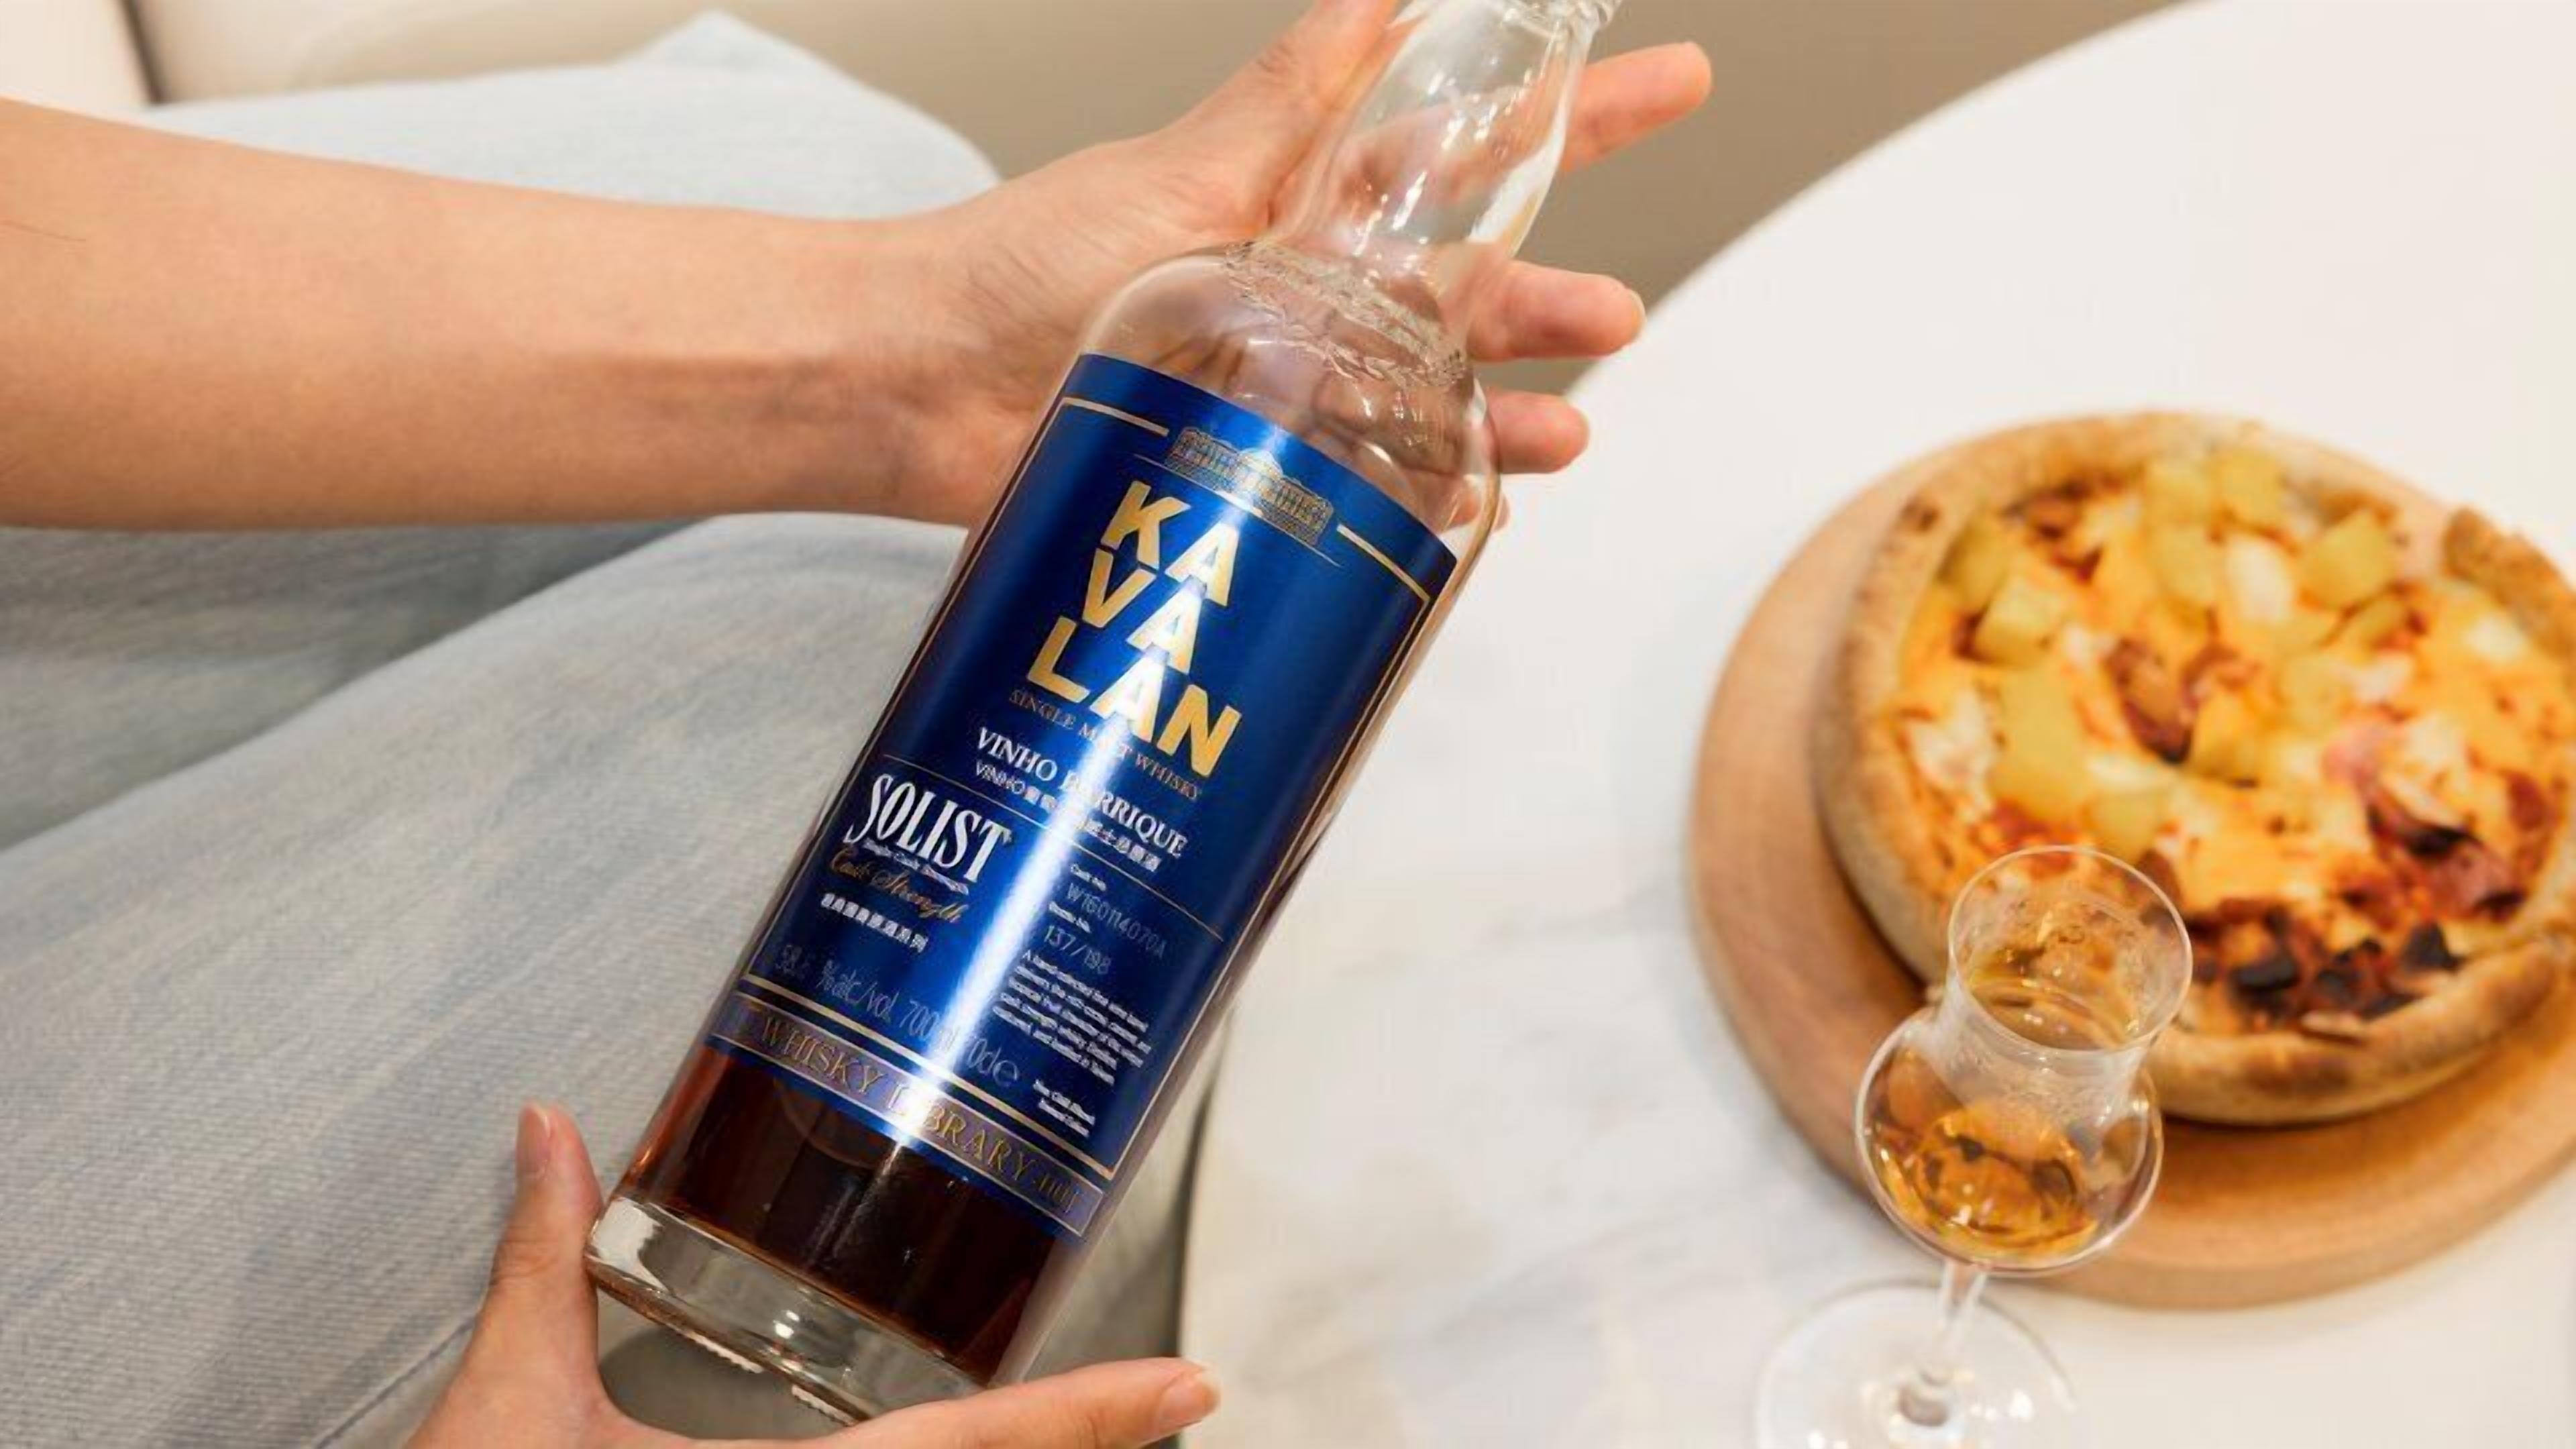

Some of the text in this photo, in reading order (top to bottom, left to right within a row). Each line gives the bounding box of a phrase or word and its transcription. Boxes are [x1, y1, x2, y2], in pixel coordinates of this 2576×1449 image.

[1101, 480, 1240, 606] KA
[1082, 548, 1206, 675] VA
[1009, 688, 1202, 802] SINGLE MT WHISKY
[1027, 616, 1242, 777] LAN
[843, 773, 1012, 883] SOLIST
[976, 727, 1189, 859] VINHO BRRIQUE
[761, 1014, 885, 1097] WHISKY
[887, 1082, 1036, 1182] LBRARY
